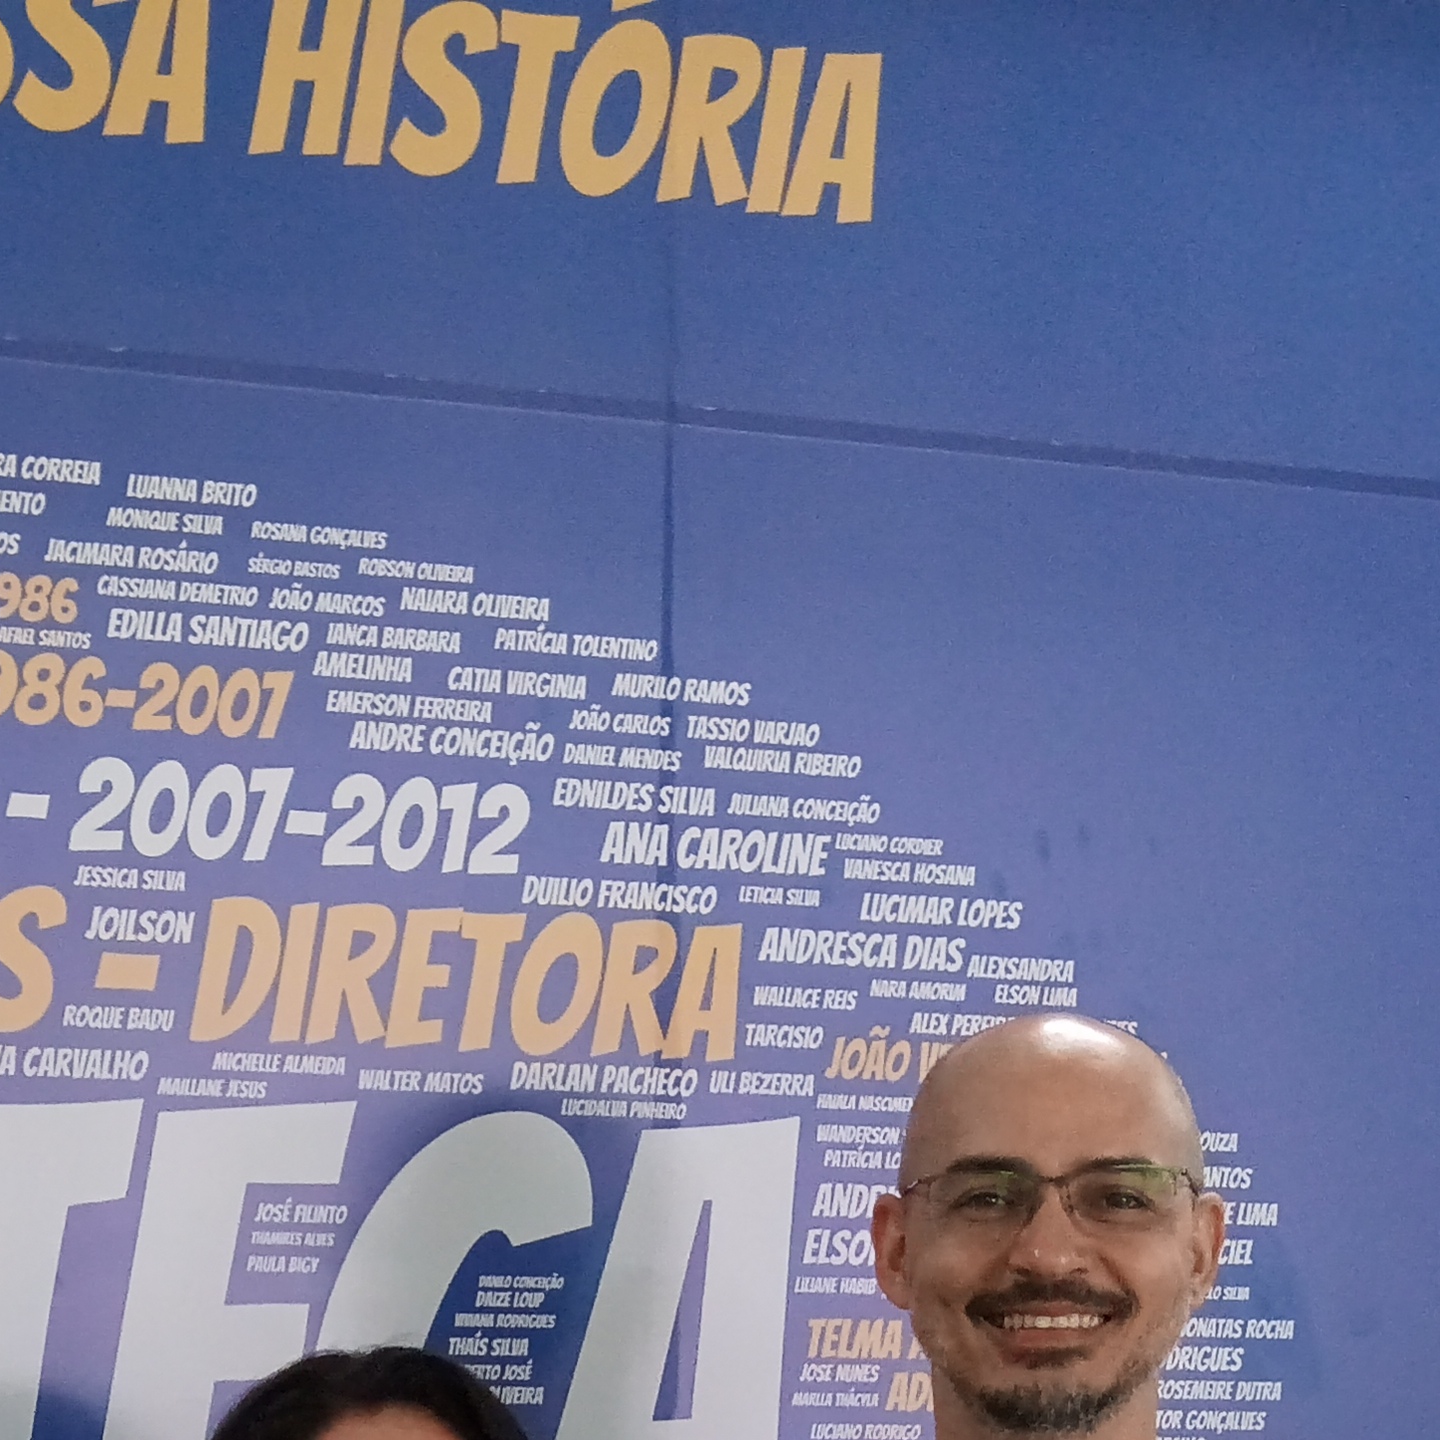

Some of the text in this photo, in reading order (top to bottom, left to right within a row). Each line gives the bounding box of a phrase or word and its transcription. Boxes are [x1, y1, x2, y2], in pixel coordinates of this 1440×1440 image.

[107, 608, 309, 652] EDILLA SANTIAGO
[611, 673, 751, 706] MURILO RAMOS
[69, 757, 530, 874] 2007-2012
[600, 821, 831, 876] ANA CAROLINE
[758, 927, 966, 972] ANDRESCA DIAS
[189, 895, 743, 1062] DIRETORA
[511, 1061, 698, 1097] DARLAN PACHECO
[808, 1319, 902, 1359] TELMA
